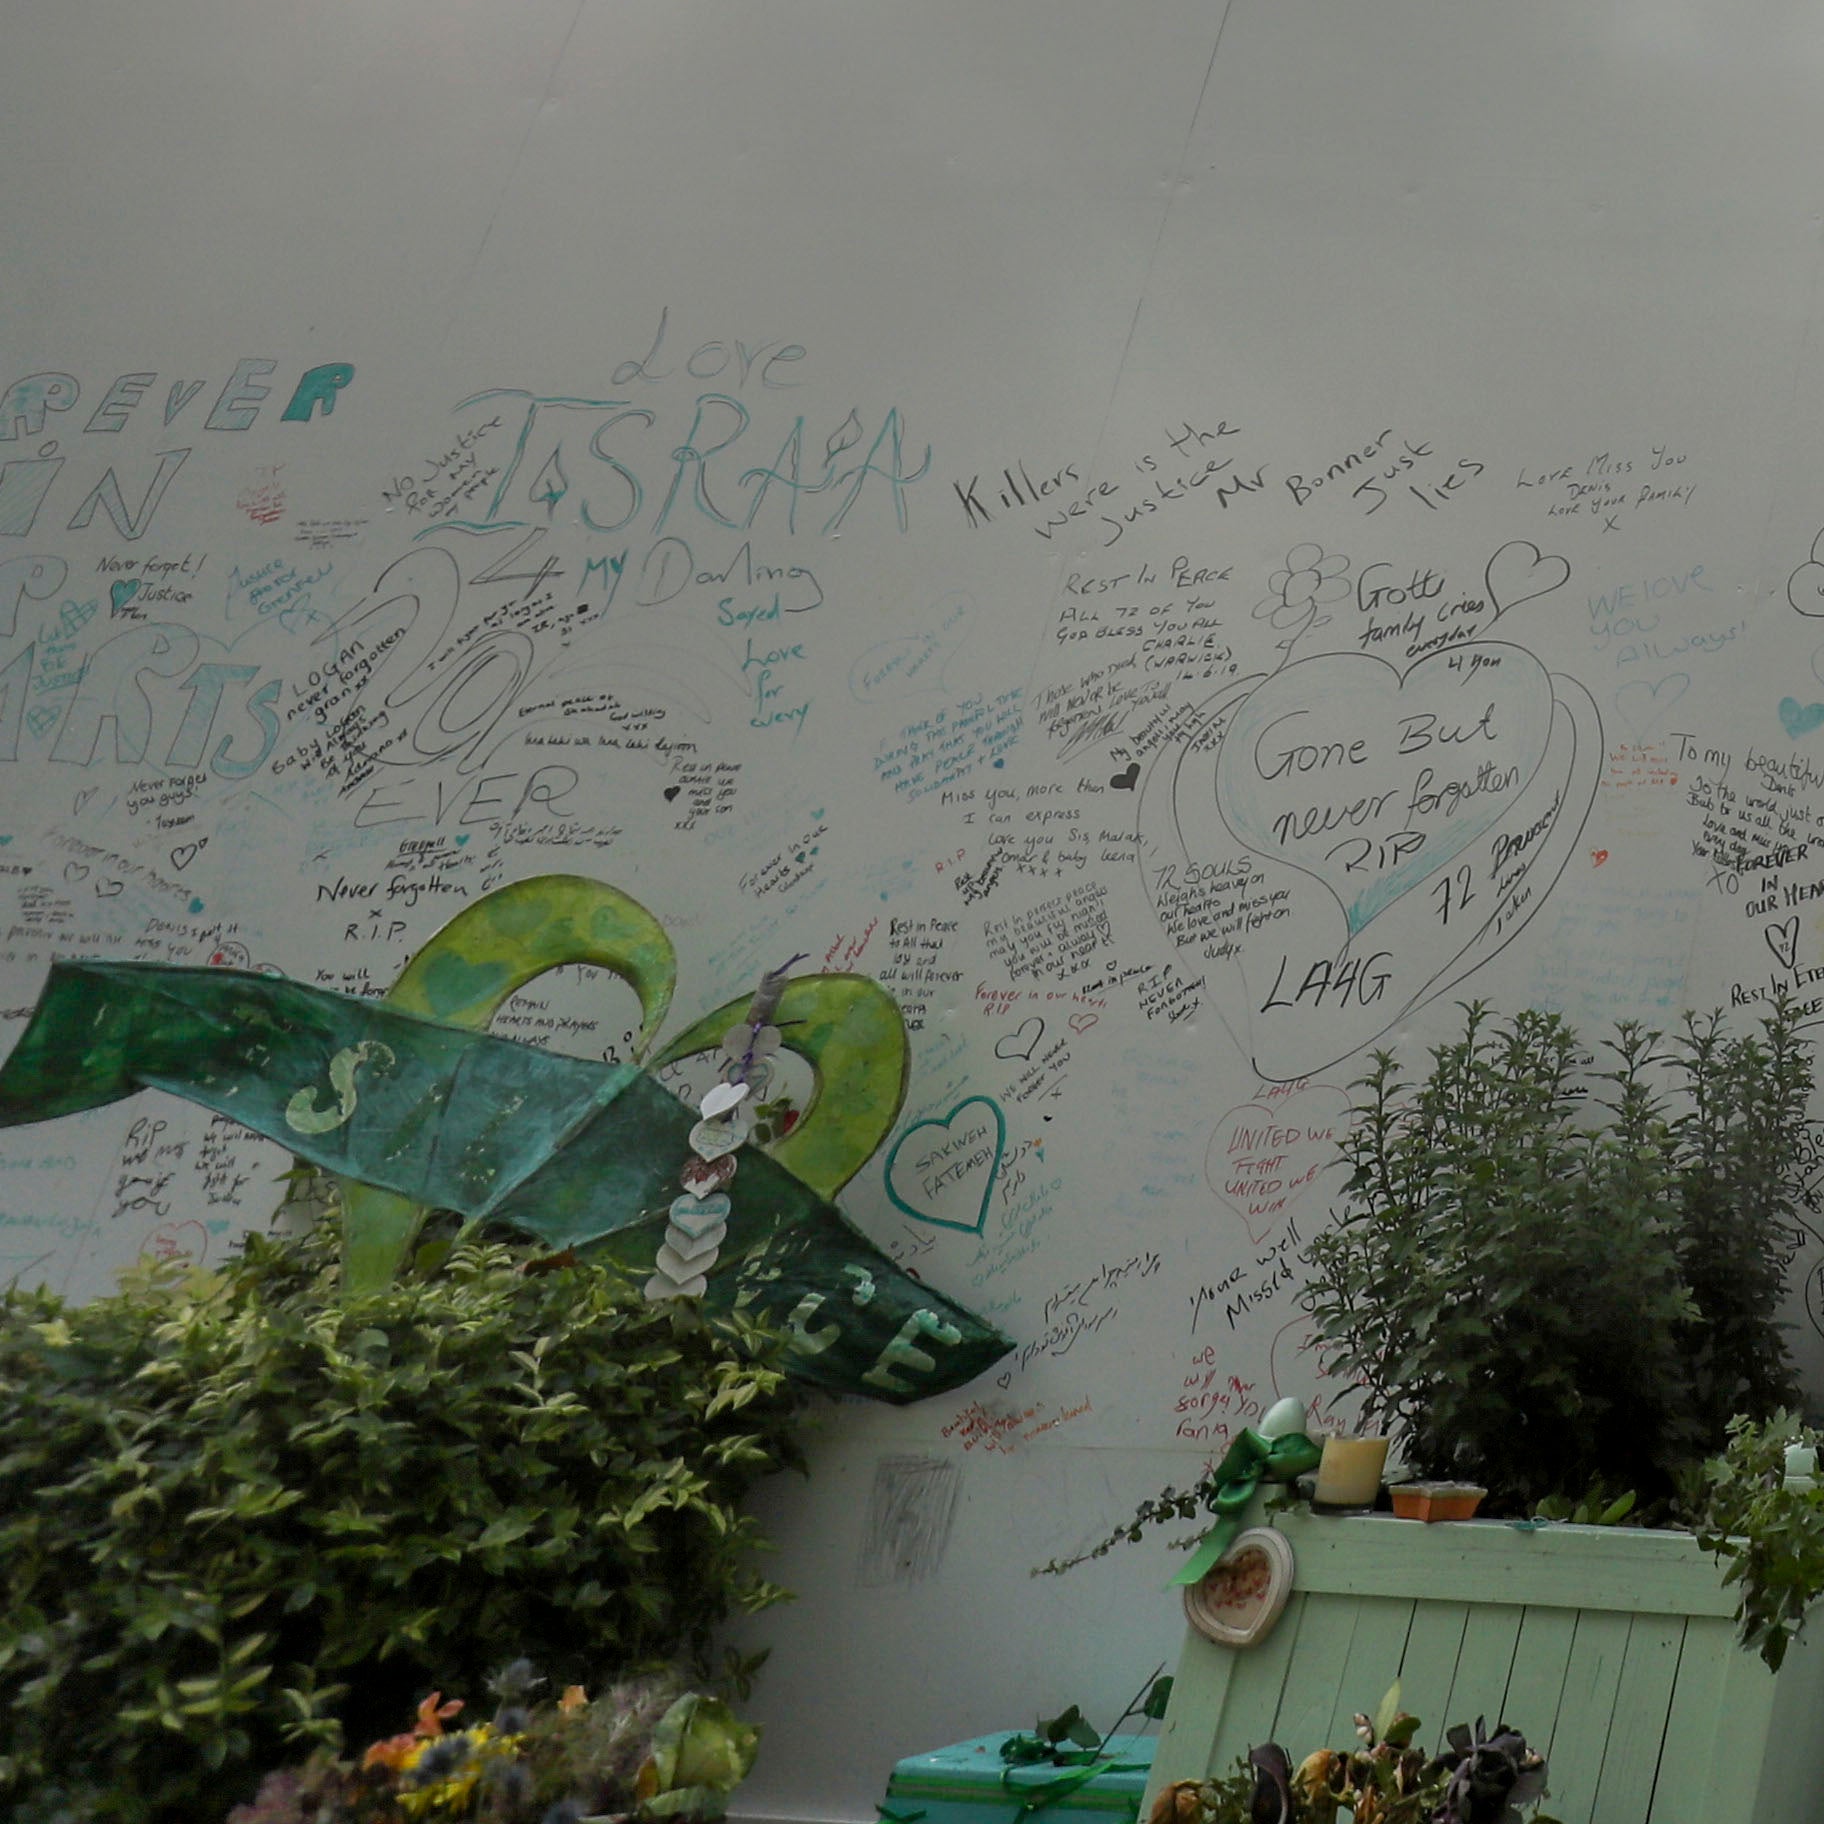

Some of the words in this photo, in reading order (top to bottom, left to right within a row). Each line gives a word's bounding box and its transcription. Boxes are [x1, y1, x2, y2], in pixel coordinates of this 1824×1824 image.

[1035, 482, 1119, 539] were
[1135, 454, 1157, 474] is
[1165, 420, 1241, 455] the
[1218, 465, 1271, 508] Mr
[1286, 430, 1392, 505] Bonner
[952, 459, 1079, 529] Killers
[636, 538, 823, 612] Darling
[1064, 573, 1130, 594] REST
[1172, 556, 1233, 588] PEACE
[138, 582, 192, 603] Justice
[293, 641, 365, 697] LOGAN
[741, 639, 807, 671] Love
[1254, 710, 1368, 780] Gone
[1398, 703, 1498, 754] But
[1670, 733, 1697, 761] To
[1705, 750, 1730, 784] my
[963, 813, 975, 823] I
[989, 814, 1011, 823] can
[1026, 809, 1080, 825] express
[1273, 790, 1399, 846] never
[1401, 764, 1520, 832] forgotten
[1324, 831, 1427, 872] RIP
[1737, 844, 1808, 872] FOREVER
[1153, 864, 1181, 890] 72
[1184, 856, 1252, 884] SOULS
[1762, 875, 1778, 892] IN
[317, 879, 379, 902] Never
[386, 877, 468, 907] forgotten
[1746, 895, 1778, 917] OUR
[890, 918, 915, 936] Rest
[931, 918, 959, 933] Peace
[975, 980, 1020, 1000] Forever
[1029, 990, 1039, 999] in
[1047, 991, 1066, 1000] our
[1732, 983, 1767, 1008] REST
[1771, 974, 1788, 994] IN
[915, 1126, 988, 1172] SAKINEH
[1227, 1126, 1300, 1154] UNITED
[1308, 1128, 1332, 1140] WE
[922, 1147, 994, 1200] FATEMEH
[1225, 1180, 1282, 1197] UNITED
[1289, 1164, 1319, 1188] WE
[1232, 1156, 1288, 1174] FIGHT
[1249, 1197, 1286, 1215] WIN
